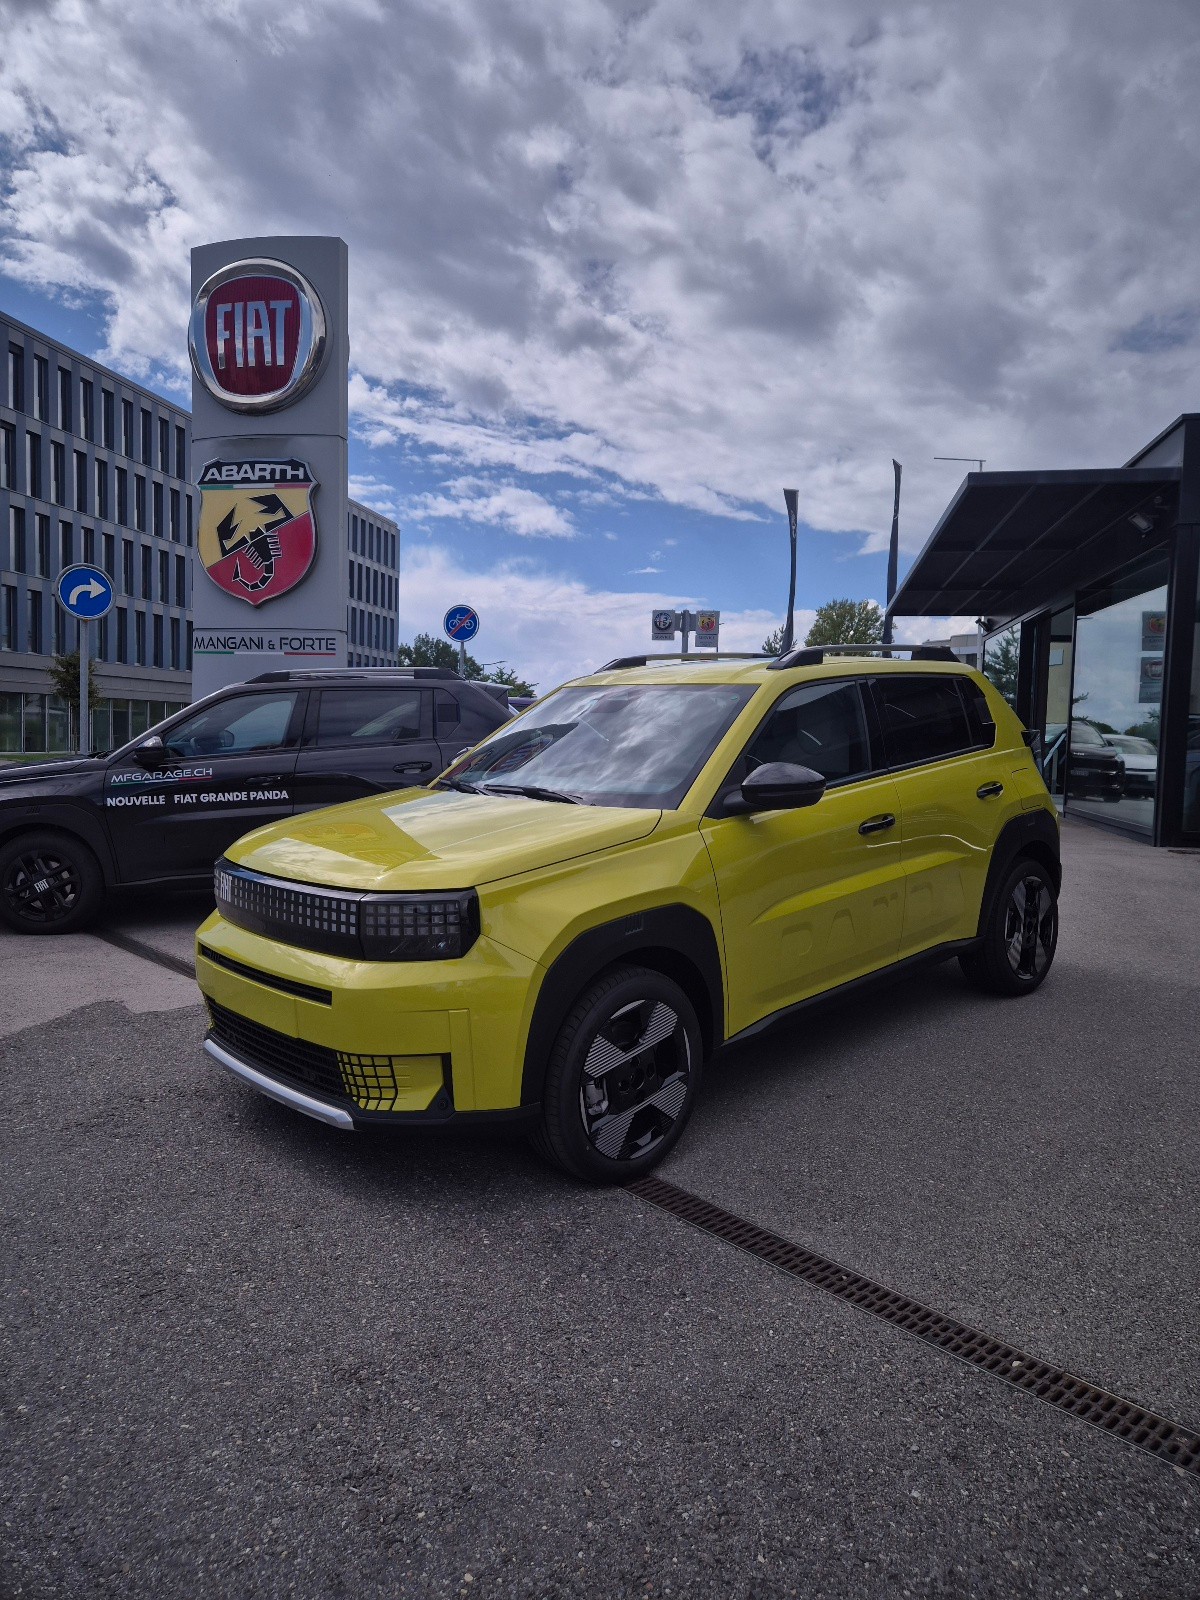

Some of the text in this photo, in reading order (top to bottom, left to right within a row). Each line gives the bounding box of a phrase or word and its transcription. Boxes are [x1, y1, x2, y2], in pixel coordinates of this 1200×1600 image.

[216, 300, 292, 370] FIAT
[204, 464, 304, 481] ABARTH
[194, 637, 336, 651] MANGANI & FORTE
[111, 768, 212, 782] MFGARAGE.CH
[106, 790, 289, 807] NOUVELLE FIAT GRANDE PANDA
[34, 879, 49, 892] FIAT
